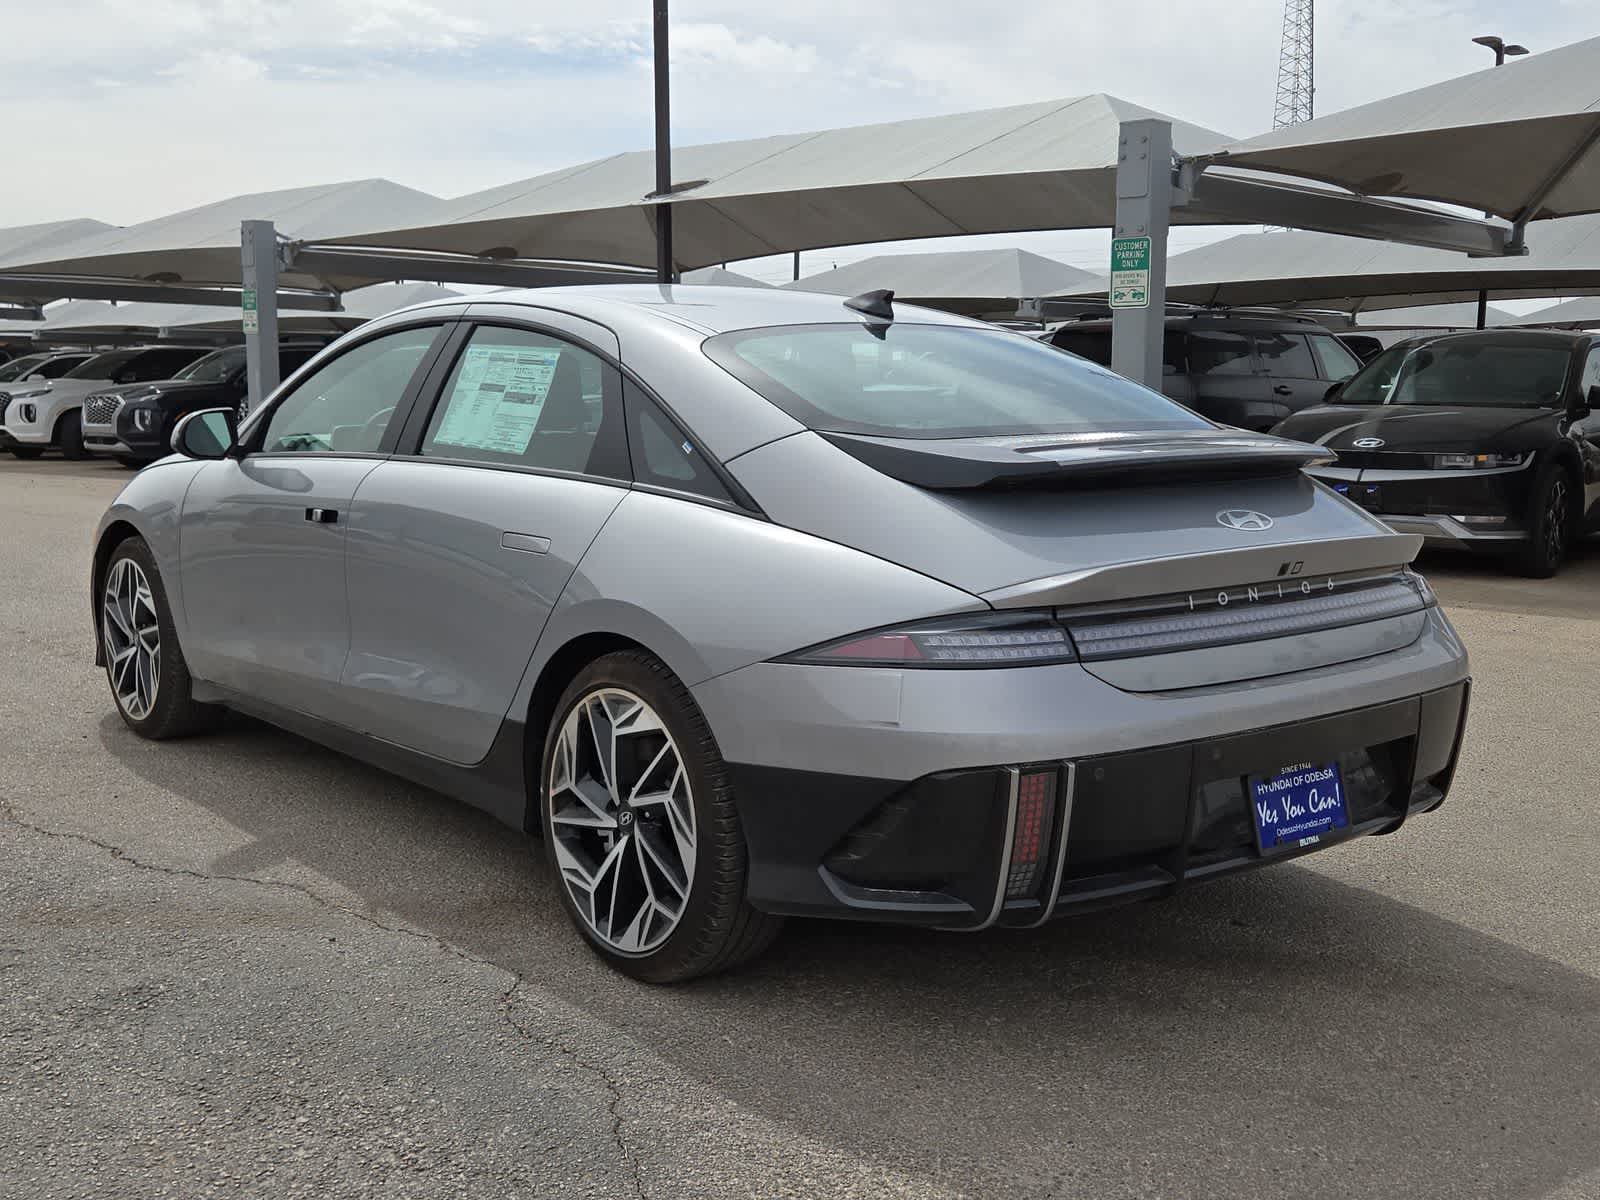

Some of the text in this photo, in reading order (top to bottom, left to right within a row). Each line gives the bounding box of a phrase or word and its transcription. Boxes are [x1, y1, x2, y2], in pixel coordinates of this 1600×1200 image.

[1114, 240, 1148, 250] CUSTOMER
[1116, 250, 1145, 259] PARKING
[1121, 259, 1139, 268] ONLY
[1281, 764, 1298, 774] SINCE
[1257, 768, 1334, 795] HYUNDAI OF ODESSA
[1257, 783, 1341, 827] Yes You Can!
[1276, 816, 1332, 837] OdessaHyundai.com
